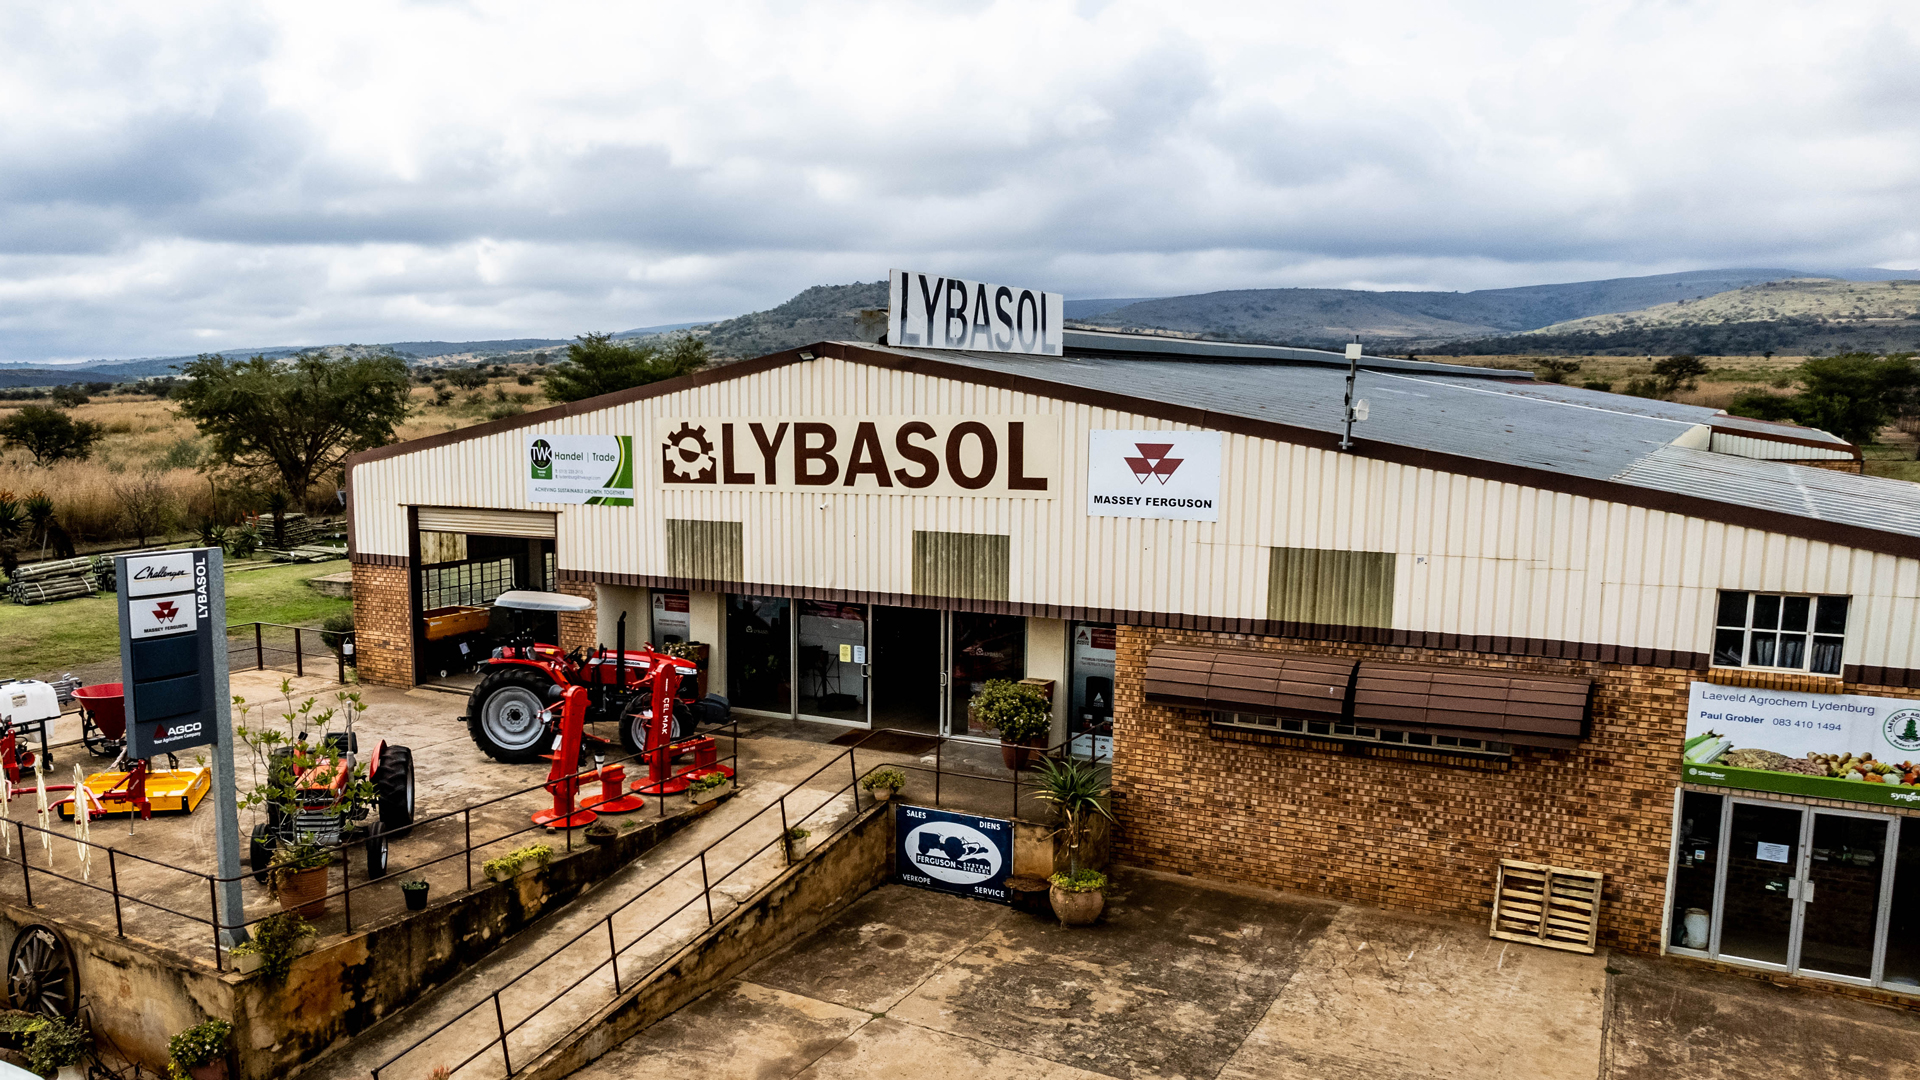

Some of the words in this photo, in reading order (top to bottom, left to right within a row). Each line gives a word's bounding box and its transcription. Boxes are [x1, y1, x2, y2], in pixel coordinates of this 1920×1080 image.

[900, 271, 1056, 354] LYBASOL
[531, 447, 552, 461] TWK
[554, 452, 584, 461] Handel
[592, 453, 616, 462] Trade
[721, 420, 1049, 491] LYBASOL
[1093, 495, 1142, 506] MASSEY
[1145, 497, 1212, 509] FERGUSON
[133, 566, 192, 582] Challenger
[195, 557, 208, 619] LYBASOL
[164, 623, 188, 631] FERGUSON
[1702, 690, 1746, 703] Laeveld
[1748, 694, 1808, 707] Agrochem
[1811, 699, 1875, 717] Lydenburg
[661, 714, 669, 735] MAK
[1700, 711, 1723, 720] Paul
[1725, 713, 1765, 724] Grobler
[1772, 718, 1792, 727] 083
[1794, 720, 1814, 729] 410
[1817, 722, 1842, 731] 1494
[167, 722, 202, 736] AGCO
[163, 734, 184, 744] Agriculture
[183, 731, 201, 739] Company
[906, 809, 927, 819] SALES
[979, 820, 1001, 831] DIENS
[917, 855, 956, 869] FERGUSON
[963, 861, 990, 871] SYSTEM
[902, 873, 931, 885] VERKOPE
[974, 886, 1005, 898] SERVICE
